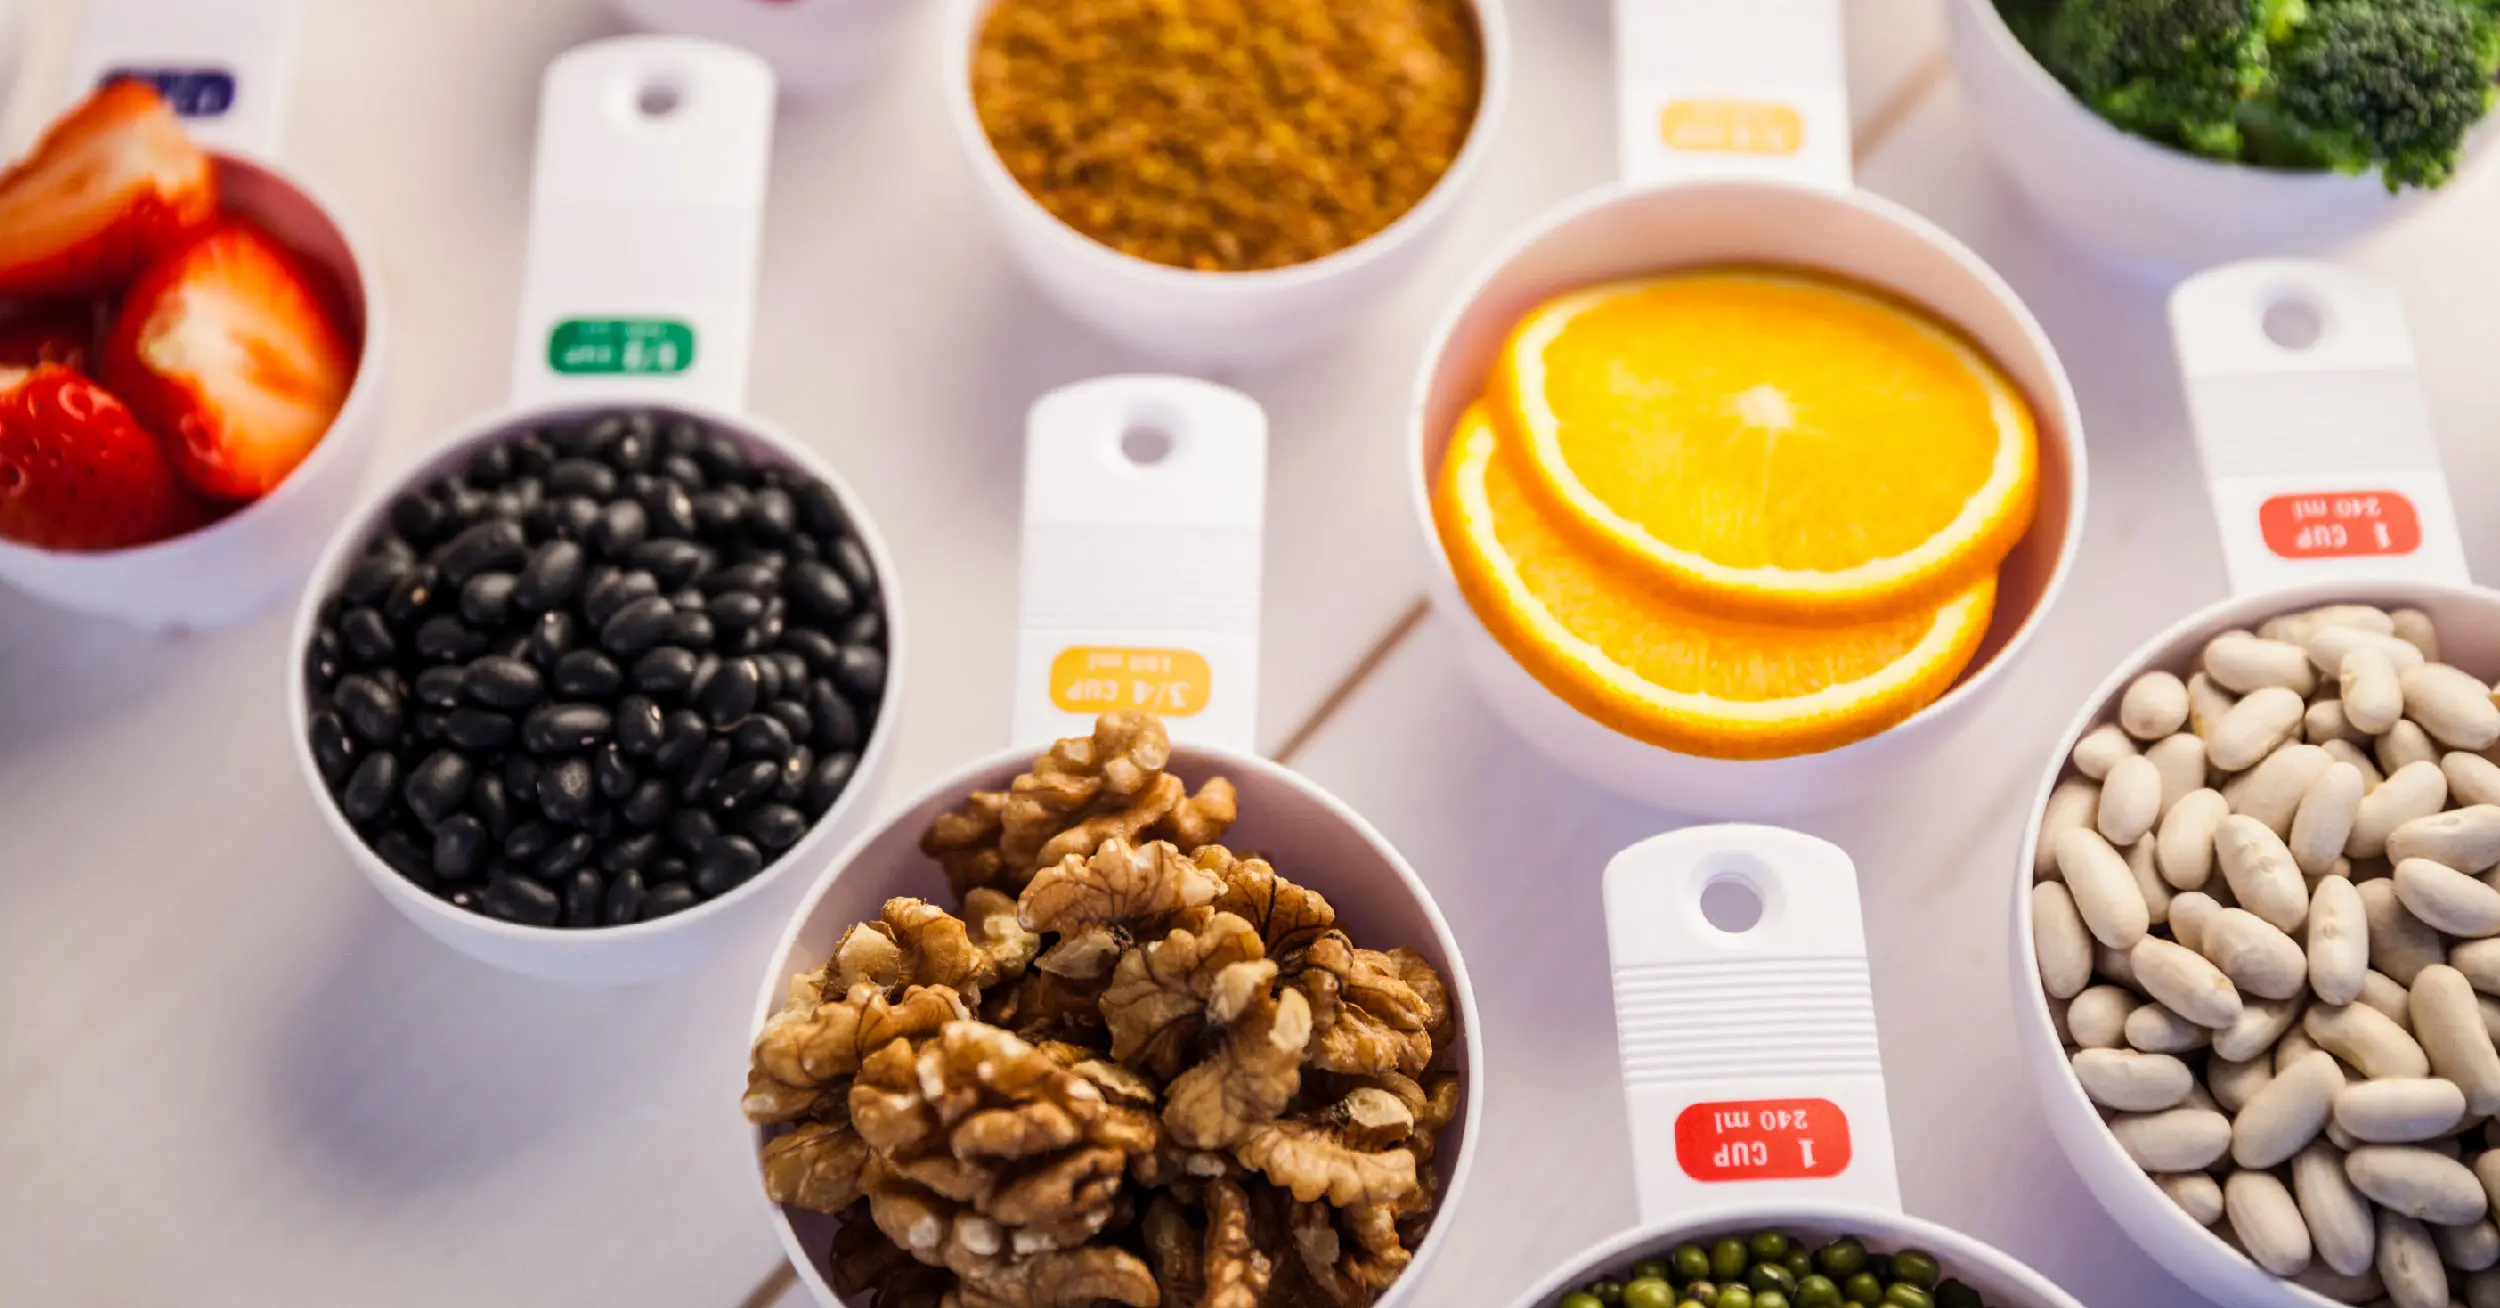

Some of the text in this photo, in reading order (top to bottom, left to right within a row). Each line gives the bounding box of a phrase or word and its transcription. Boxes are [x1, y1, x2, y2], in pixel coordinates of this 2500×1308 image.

[2292, 497, 2381, 522] 240 ml
[2296, 522, 2391, 549] 1 CUP
[1065, 679, 1190, 709] 3/4 CUP
[1714, 1109, 1808, 1135] 240 ml
[1713, 1138, 1817, 1169] 1 CUP
